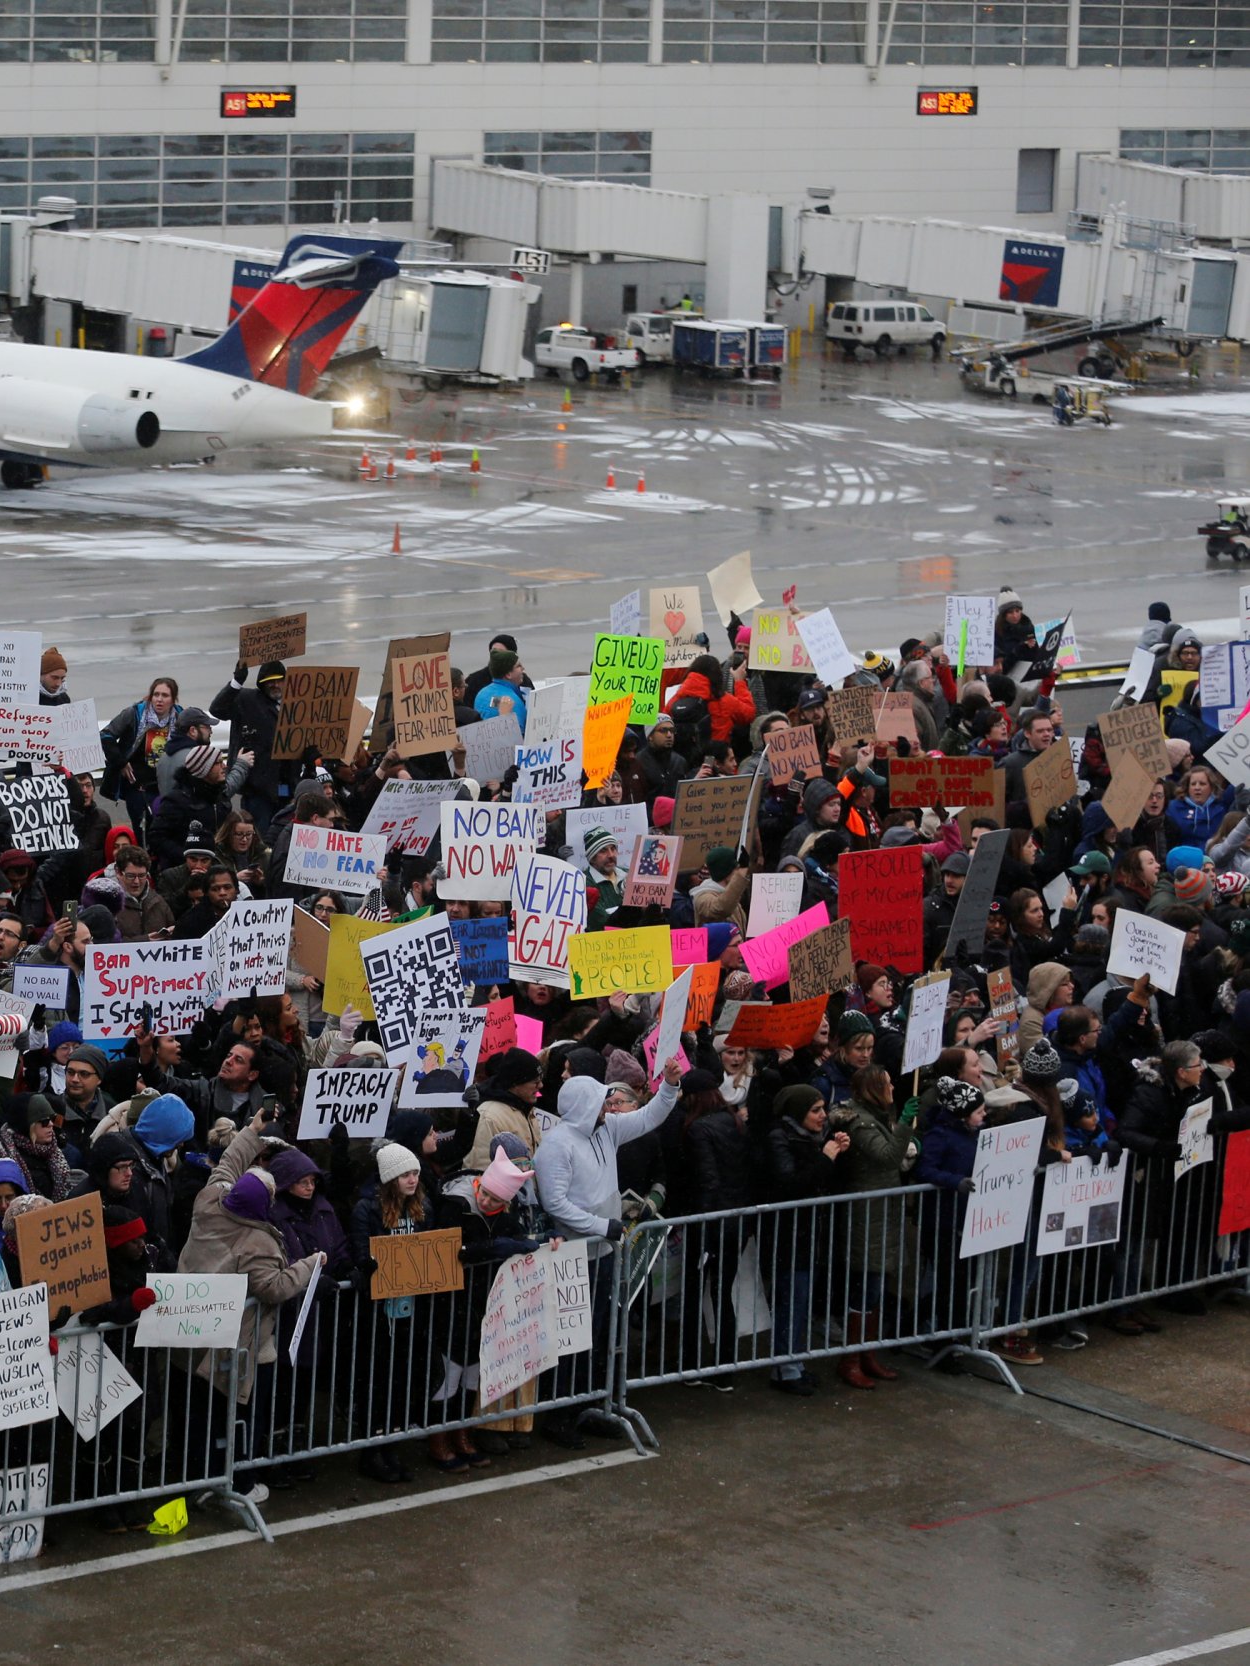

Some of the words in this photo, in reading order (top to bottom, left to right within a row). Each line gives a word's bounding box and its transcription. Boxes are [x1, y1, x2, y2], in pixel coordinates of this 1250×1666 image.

[226, 100, 246, 110] A51
[517, 252, 547, 271] A51
[1021, 248, 1050, 257] DELTA
[665, 595, 684, 610] We
[759, 615, 779, 635] NO
[757, 645, 781, 664] NO
[399, 655, 448, 693] LOVE
[595, 672, 626, 691] YOUR
[631, 676, 658, 694] TIRED
[286, 673, 311, 698] NO
[313, 672, 353, 699] BAN
[280, 702, 307, 726] NO
[311, 701, 350, 724] WALL
[401, 689, 448, 717] TRUMPS
[21, 726, 50, 739] away
[769, 734, 786, 753] NO
[790, 730, 814, 748] BAN
[1105, 719, 1160, 748] REFUGEES
[8, 750, 50, 762] DOOFUS
[517, 748, 553, 769] HOW
[561, 740, 575, 762] IS
[530, 764, 566, 787] THIS
[772, 758, 787, 776] NO
[12, 806, 42, 831] DO
[47, 800, 72, 822] NOT
[454, 808, 491, 839] NO
[497, 808, 537, 838] BAN
[580, 811, 605, 824] GIVE
[615, 808, 630, 820] ME
[297, 830, 319, 849] NO
[326, 832, 363, 853] HATE
[700, 841, 723, 851] FREE
[303, 852, 328, 869] NO
[337, 854, 375, 876] FEAR
[447, 845, 484, 879] NO
[510, 857, 585, 925] NEVER
[648, 886, 668, 896] BAN
[229, 935, 254, 956] that
[577, 938, 601, 954] This
[618, 933, 637, 950] not
[93, 951, 130, 970] Ban
[137, 944, 203, 963] White
[24, 975, 38, 985] NO
[40, 977, 59, 985] BAN
[228, 972, 253, 992] Never
[588, 961, 662, 990] PEOPLE!
[20, 990, 35, 999] NO
[37, 991, 60, 1000] WALL
[992, 982, 1011, 995] STAND
[316, 1070, 394, 1099] IMPEACH
[316, 1103, 379, 1124] TRUMP
[975, 1168, 1024, 1196] Trumps
[41, 1207, 96, 1243] JEWS
[971, 1208, 1011, 1238] Hate
[40, 1236, 93, 1271] against
[376, 1235, 460, 1292] RESIST
[510, 1253, 534, 1274] me
[515, 1266, 546, 1288] tired
[154, 1279, 175, 1303] SO
[186, 1281, 210, 1300] DO
[557, 1284, 588, 1306] NOT
